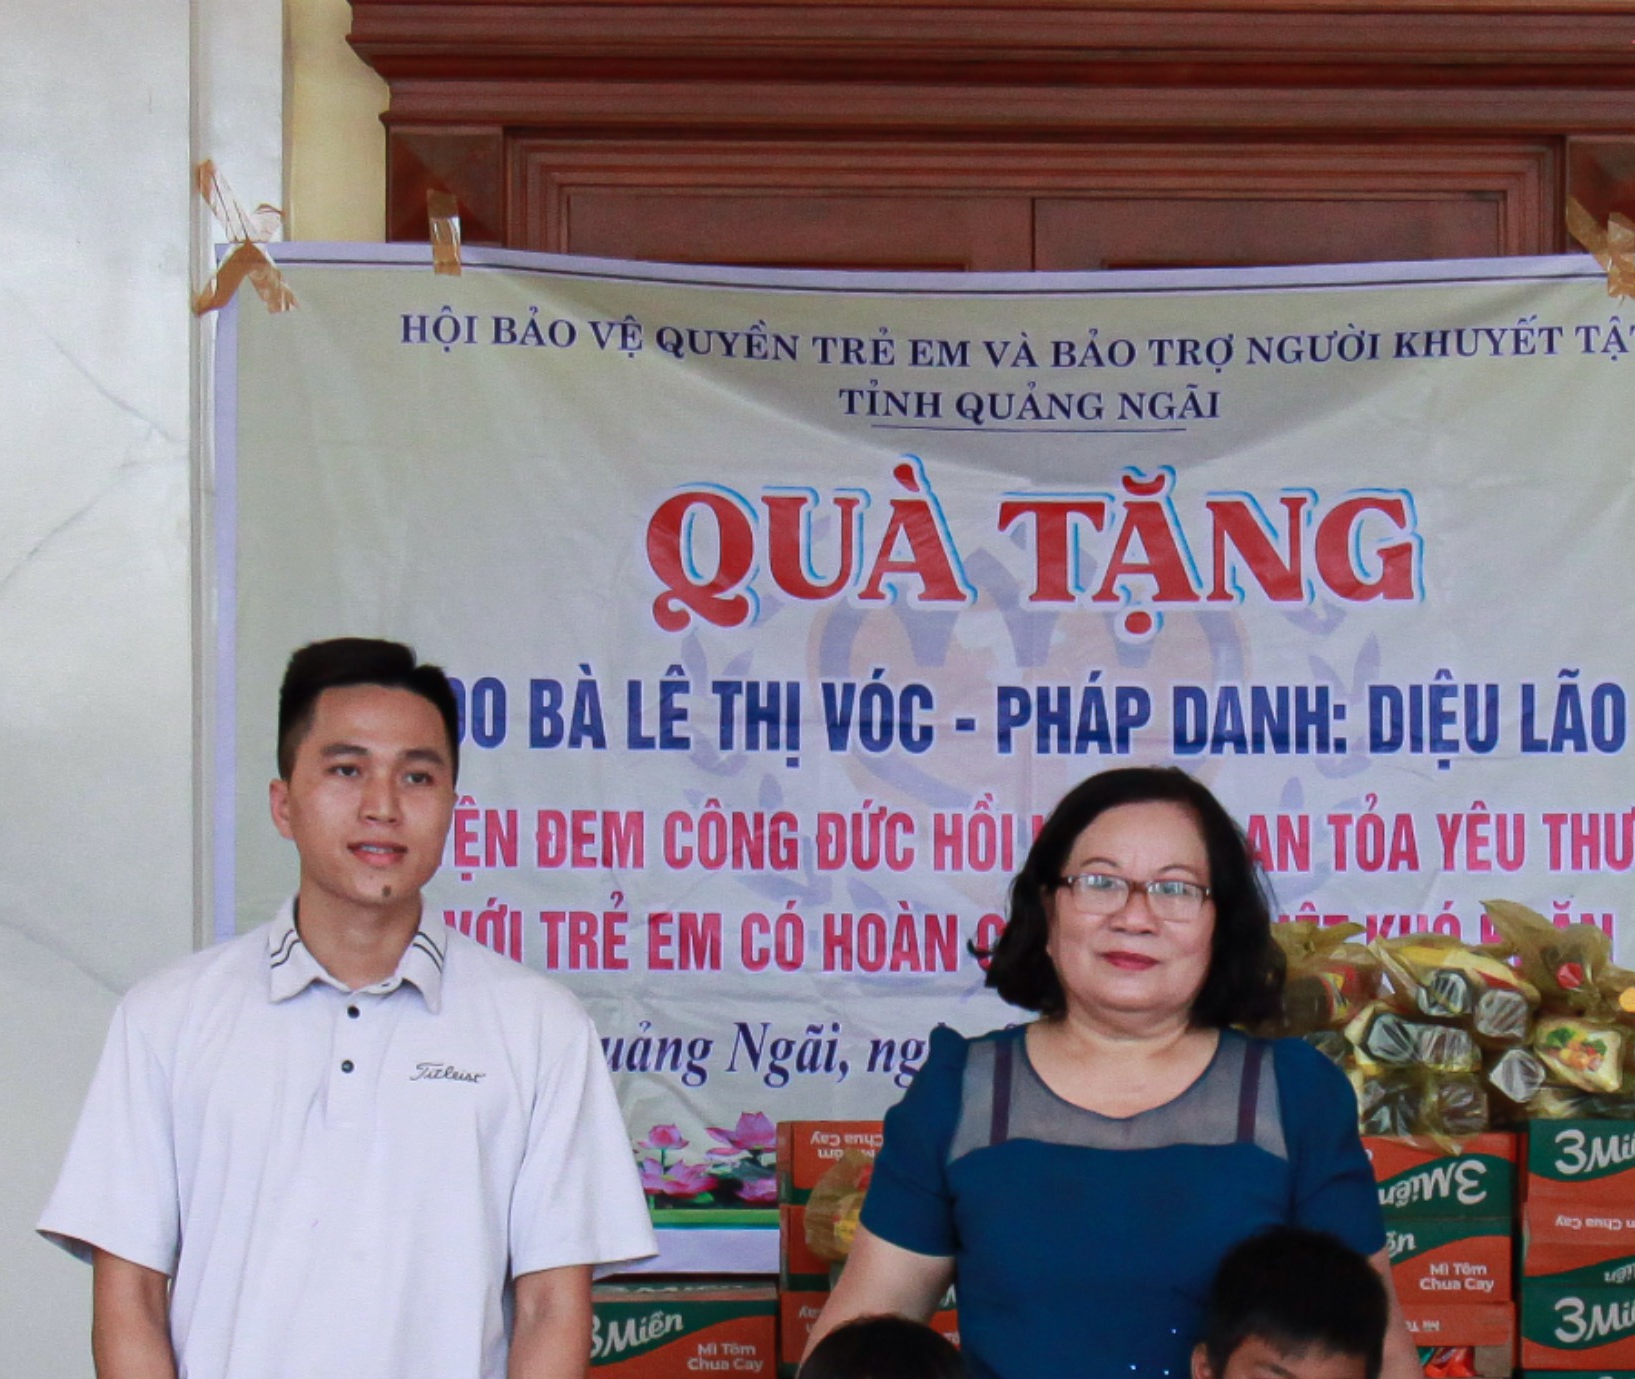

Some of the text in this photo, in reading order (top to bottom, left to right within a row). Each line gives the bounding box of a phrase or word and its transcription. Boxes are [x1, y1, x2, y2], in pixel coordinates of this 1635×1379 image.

[400, 305, 477, 358] HỘI
[492, 306, 576, 349] BẢO
[589, 315, 643, 360] VỆ
[656, 318, 800, 364] QUYỀN
[812, 327, 895, 368] TRẺ
[908, 338, 970, 368] EM
[984, 331, 1037, 368] VÀ
[1052, 327, 1136, 368] BẢO
[1149, 335, 1236, 373] TRỢ
[1246, 324, 1380, 365] NGƯỜI
[1393, 315, 1563, 360] KHUYẾT
[838, 380, 1221, 425] TỈNH QUẢNG NGÃI
[646, 460, 1418, 635] QUÀ TẶNG
[530, 665, 607, 750] BÀ
[627, 665, 694, 751] LÊ
[713, 678, 802, 768] THỊ
[823, 668, 935, 754] VÓC
[997, 671, 1151, 755] PHÁP
[1173, 686, 1346, 754] DANH:
[1368, 669, 1498, 769] DIỆU
[1523, 669, 1626, 754] LÃO
[535, 809, 645, 869] ĐEM
[664, 799, 799, 870] CÔNG
[815, 800, 914, 871] ĐỨC
[934, 793, 1015, 872] HỒI
[1327, 793, 1420, 871] TỎA
[1439, 800, 1525, 871] YÊU
[540, 891, 627, 970] TRẺ
[648, 914, 721, 970] EM
[741, 902, 803, 971] CÓ
[823, 902, 959, 971] HOÀN
[601, 1021, 850, 1089] uảng Ngãi,
[1420, 1277, 1494, 1293] Chua Cay
[1452, 1262, 1487, 1276] Tôm
[687, 1358, 763, 1372] Chua Cay
